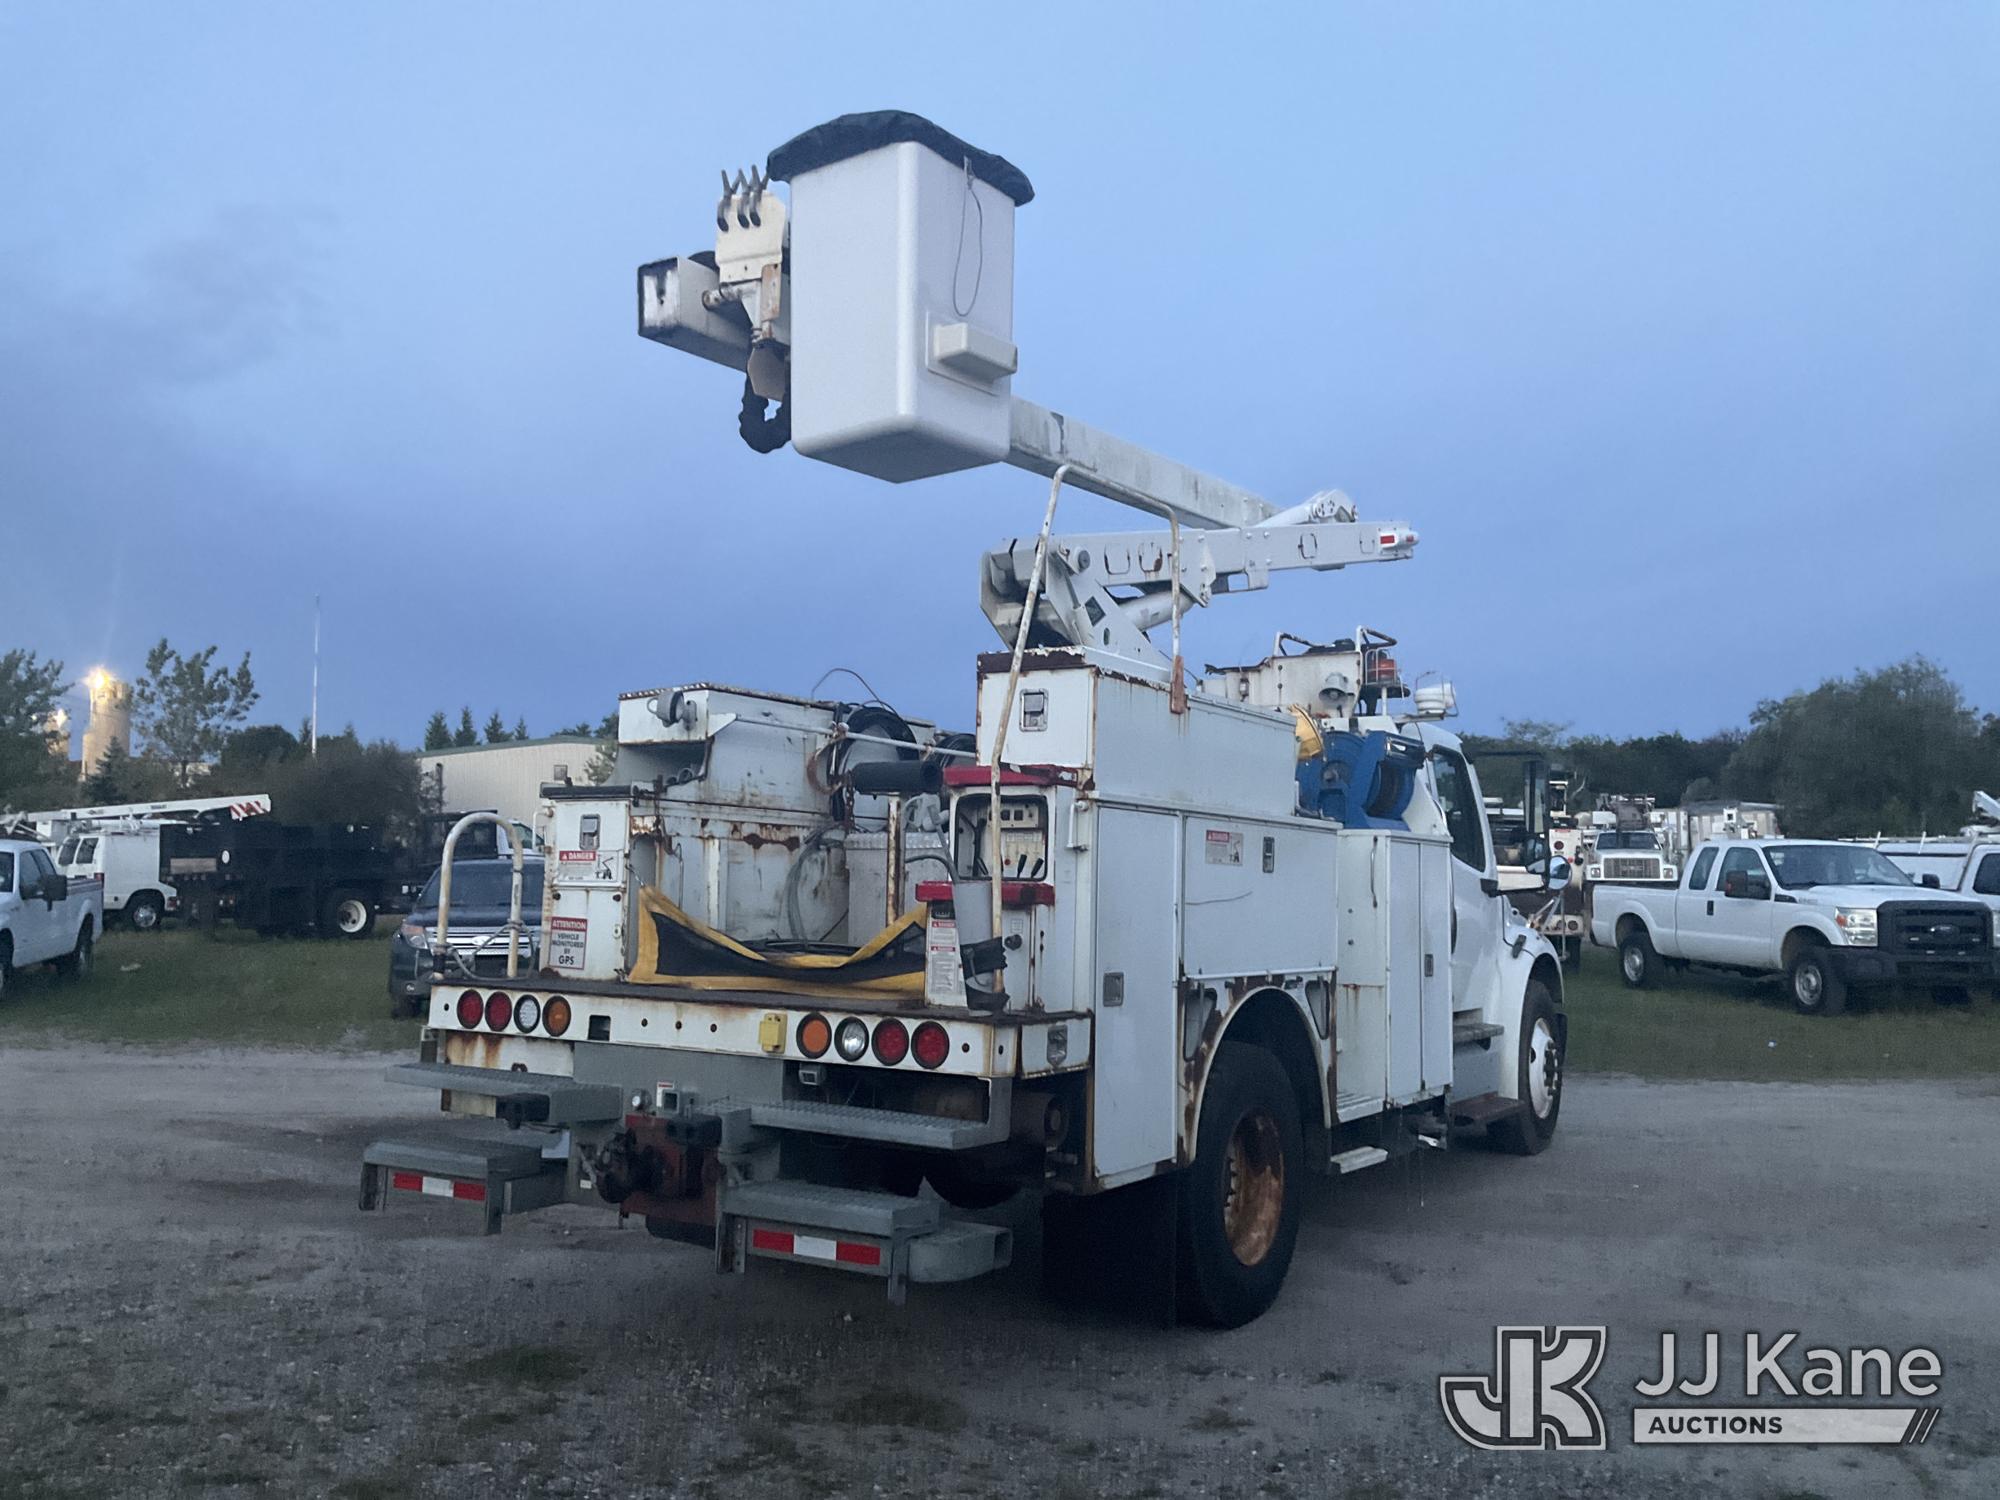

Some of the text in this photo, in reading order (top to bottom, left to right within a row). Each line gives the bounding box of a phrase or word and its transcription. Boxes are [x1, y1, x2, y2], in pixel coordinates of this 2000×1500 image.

[568, 852, 594, 860] DANGER
[552, 919, 586, 930] ATTENTION
[557, 932, 580, 940] VEHICLE
[552, 940, 584, 948] MONITORED
[558, 955, 575, 965] GPS
